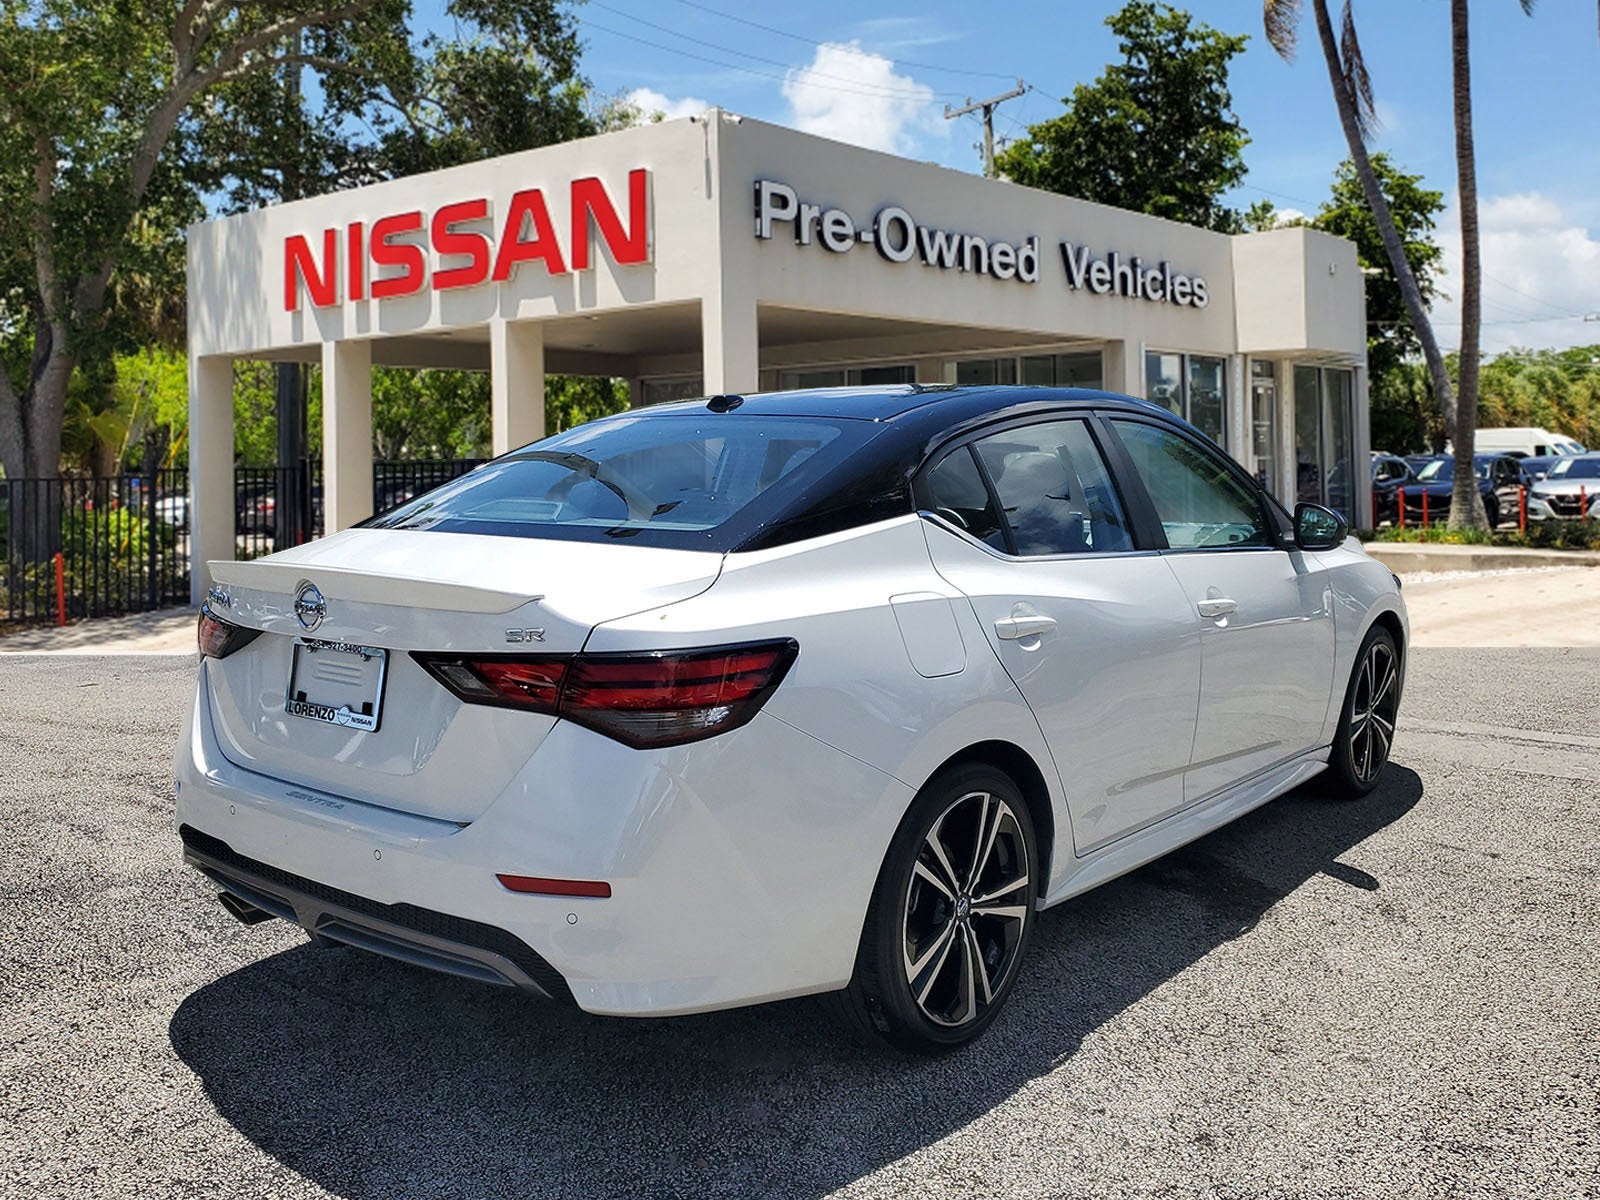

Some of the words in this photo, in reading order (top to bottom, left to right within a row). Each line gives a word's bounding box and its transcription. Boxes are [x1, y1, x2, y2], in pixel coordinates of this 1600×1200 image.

[284, 168, 649, 312] NISSAN
[754, 180, 1039, 283] Pre-Owned
[1060, 240, 1208, 308] Vehicles
[505, 627, 545, 643] SR
[288, 702, 335, 721] LORENZO
